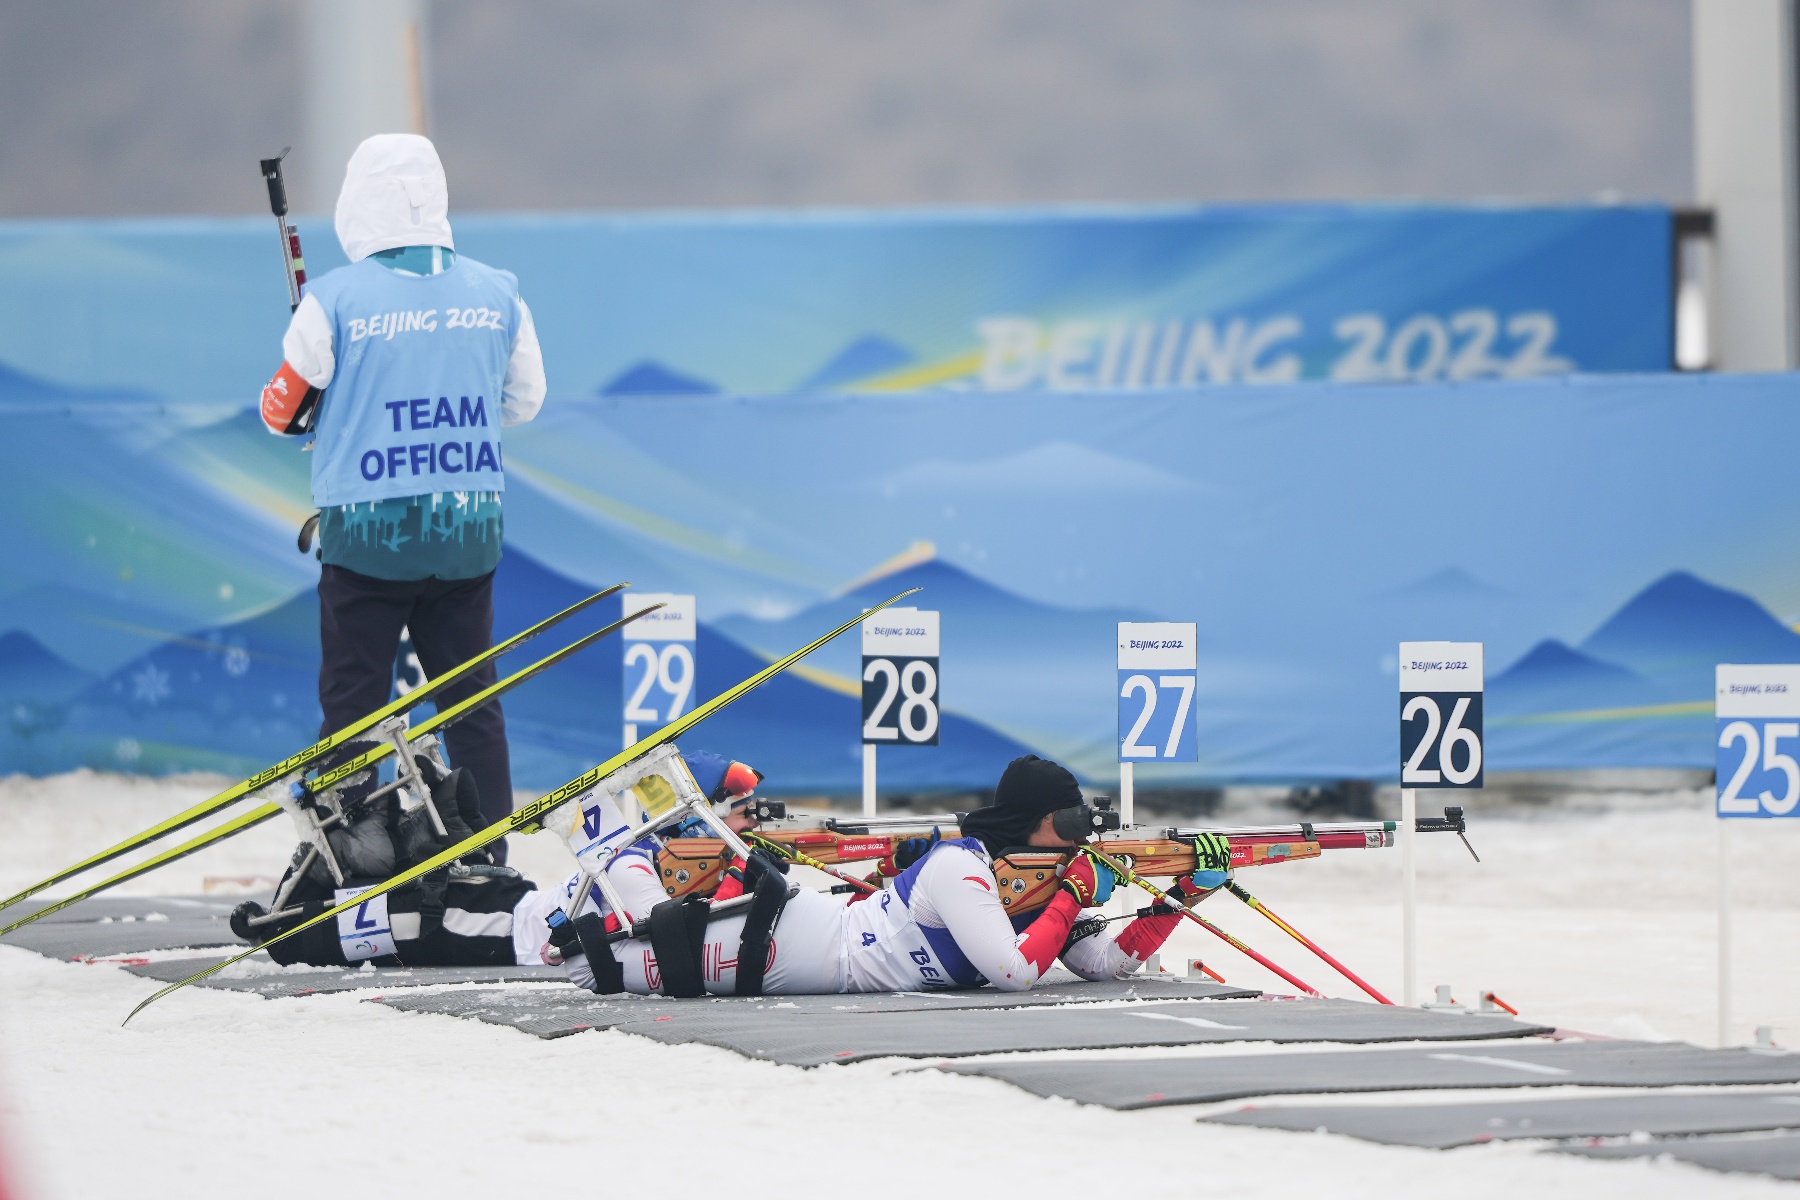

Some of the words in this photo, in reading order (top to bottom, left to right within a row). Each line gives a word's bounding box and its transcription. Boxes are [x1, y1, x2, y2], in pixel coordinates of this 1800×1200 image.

[349, 309, 438, 342] BEIJING
[446, 307, 505, 330] 2022
[1330, 309, 1577, 385] 2022
[385, 395, 488, 432] TEAM
[360, 440, 503, 481] OFFICIA
[874, 626, 903, 638] BEIJING
[905, 627, 928, 636] 2022
[1129, 639, 1159, 651] BEIJING
[1161, 640, 1184, 649] 2022
[623, 643, 695, 722] 29
[1411, 661, 1442, 673] BEIJING
[1445, 661, 1469, 670] 2022
[863, 658, 938, 743] 28
[1120, 674, 1196, 758] 27
[1401, 695, 1482, 785] 26
[248, 737, 333, 788] FISCHER
[308, 753, 369, 790] FISCH
[1718, 720, 1800, 816] 25
[510, 768, 599, 826] FISCHER
[843, 844, 866, 853] BEIJING
[1069, 874, 1090, 897] LEKI
[355, 900, 377, 930] 7
[861, 931, 877, 947] 4
